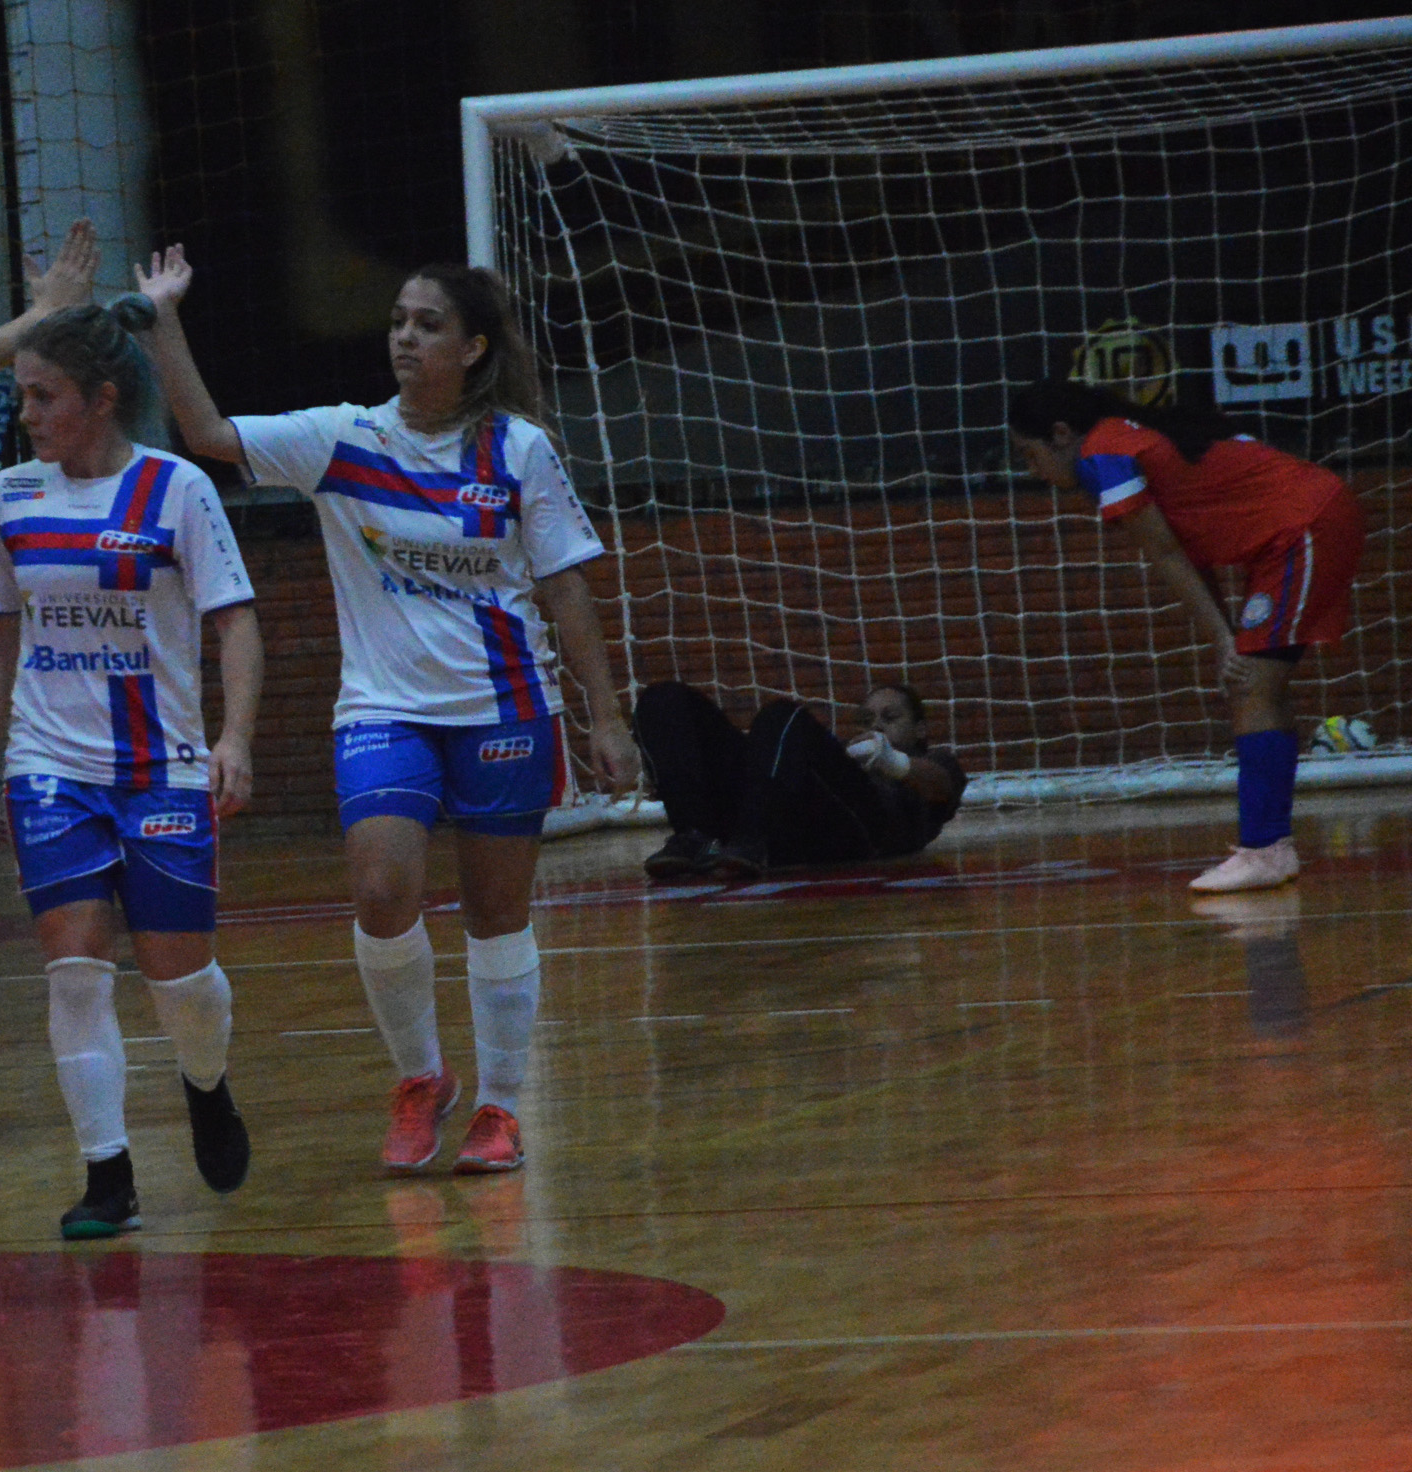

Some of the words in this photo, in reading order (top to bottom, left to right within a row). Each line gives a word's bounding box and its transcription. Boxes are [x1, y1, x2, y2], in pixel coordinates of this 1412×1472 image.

[392, 549, 502, 576] FEEVALE
[41, 606, 147, 630] FEEVALE
[32, 644, 150, 671] Banrisul
[479, 736, 535, 762] UJR
